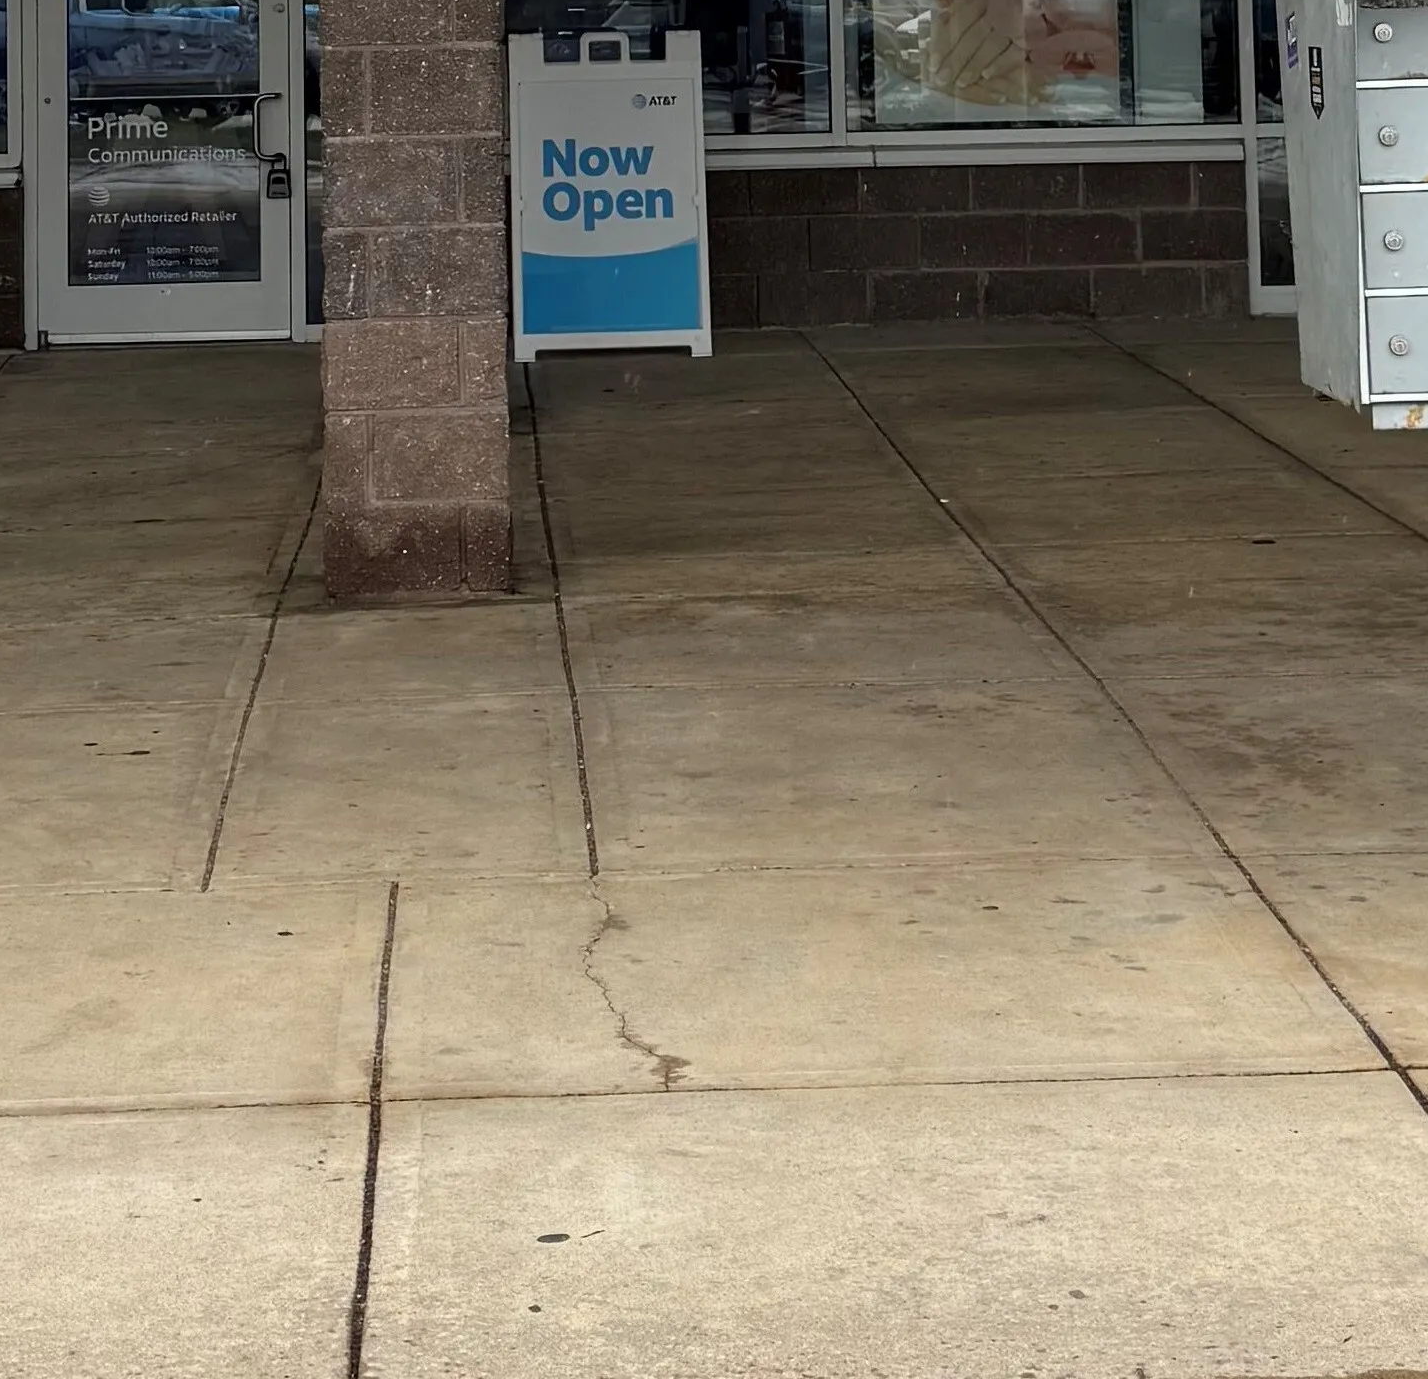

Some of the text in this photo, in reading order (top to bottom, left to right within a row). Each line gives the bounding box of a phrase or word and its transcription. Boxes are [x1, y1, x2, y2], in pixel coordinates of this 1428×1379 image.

[648, 95, 678, 106] AT&T
[87, 116, 169, 140] Prime
[87, 144, 247, 164] Communications
[542, 138, 655, 178] Now
[88, 211, 237, 224] AT&T Authorized Retailer
[542, 182, 674, 232] Open
